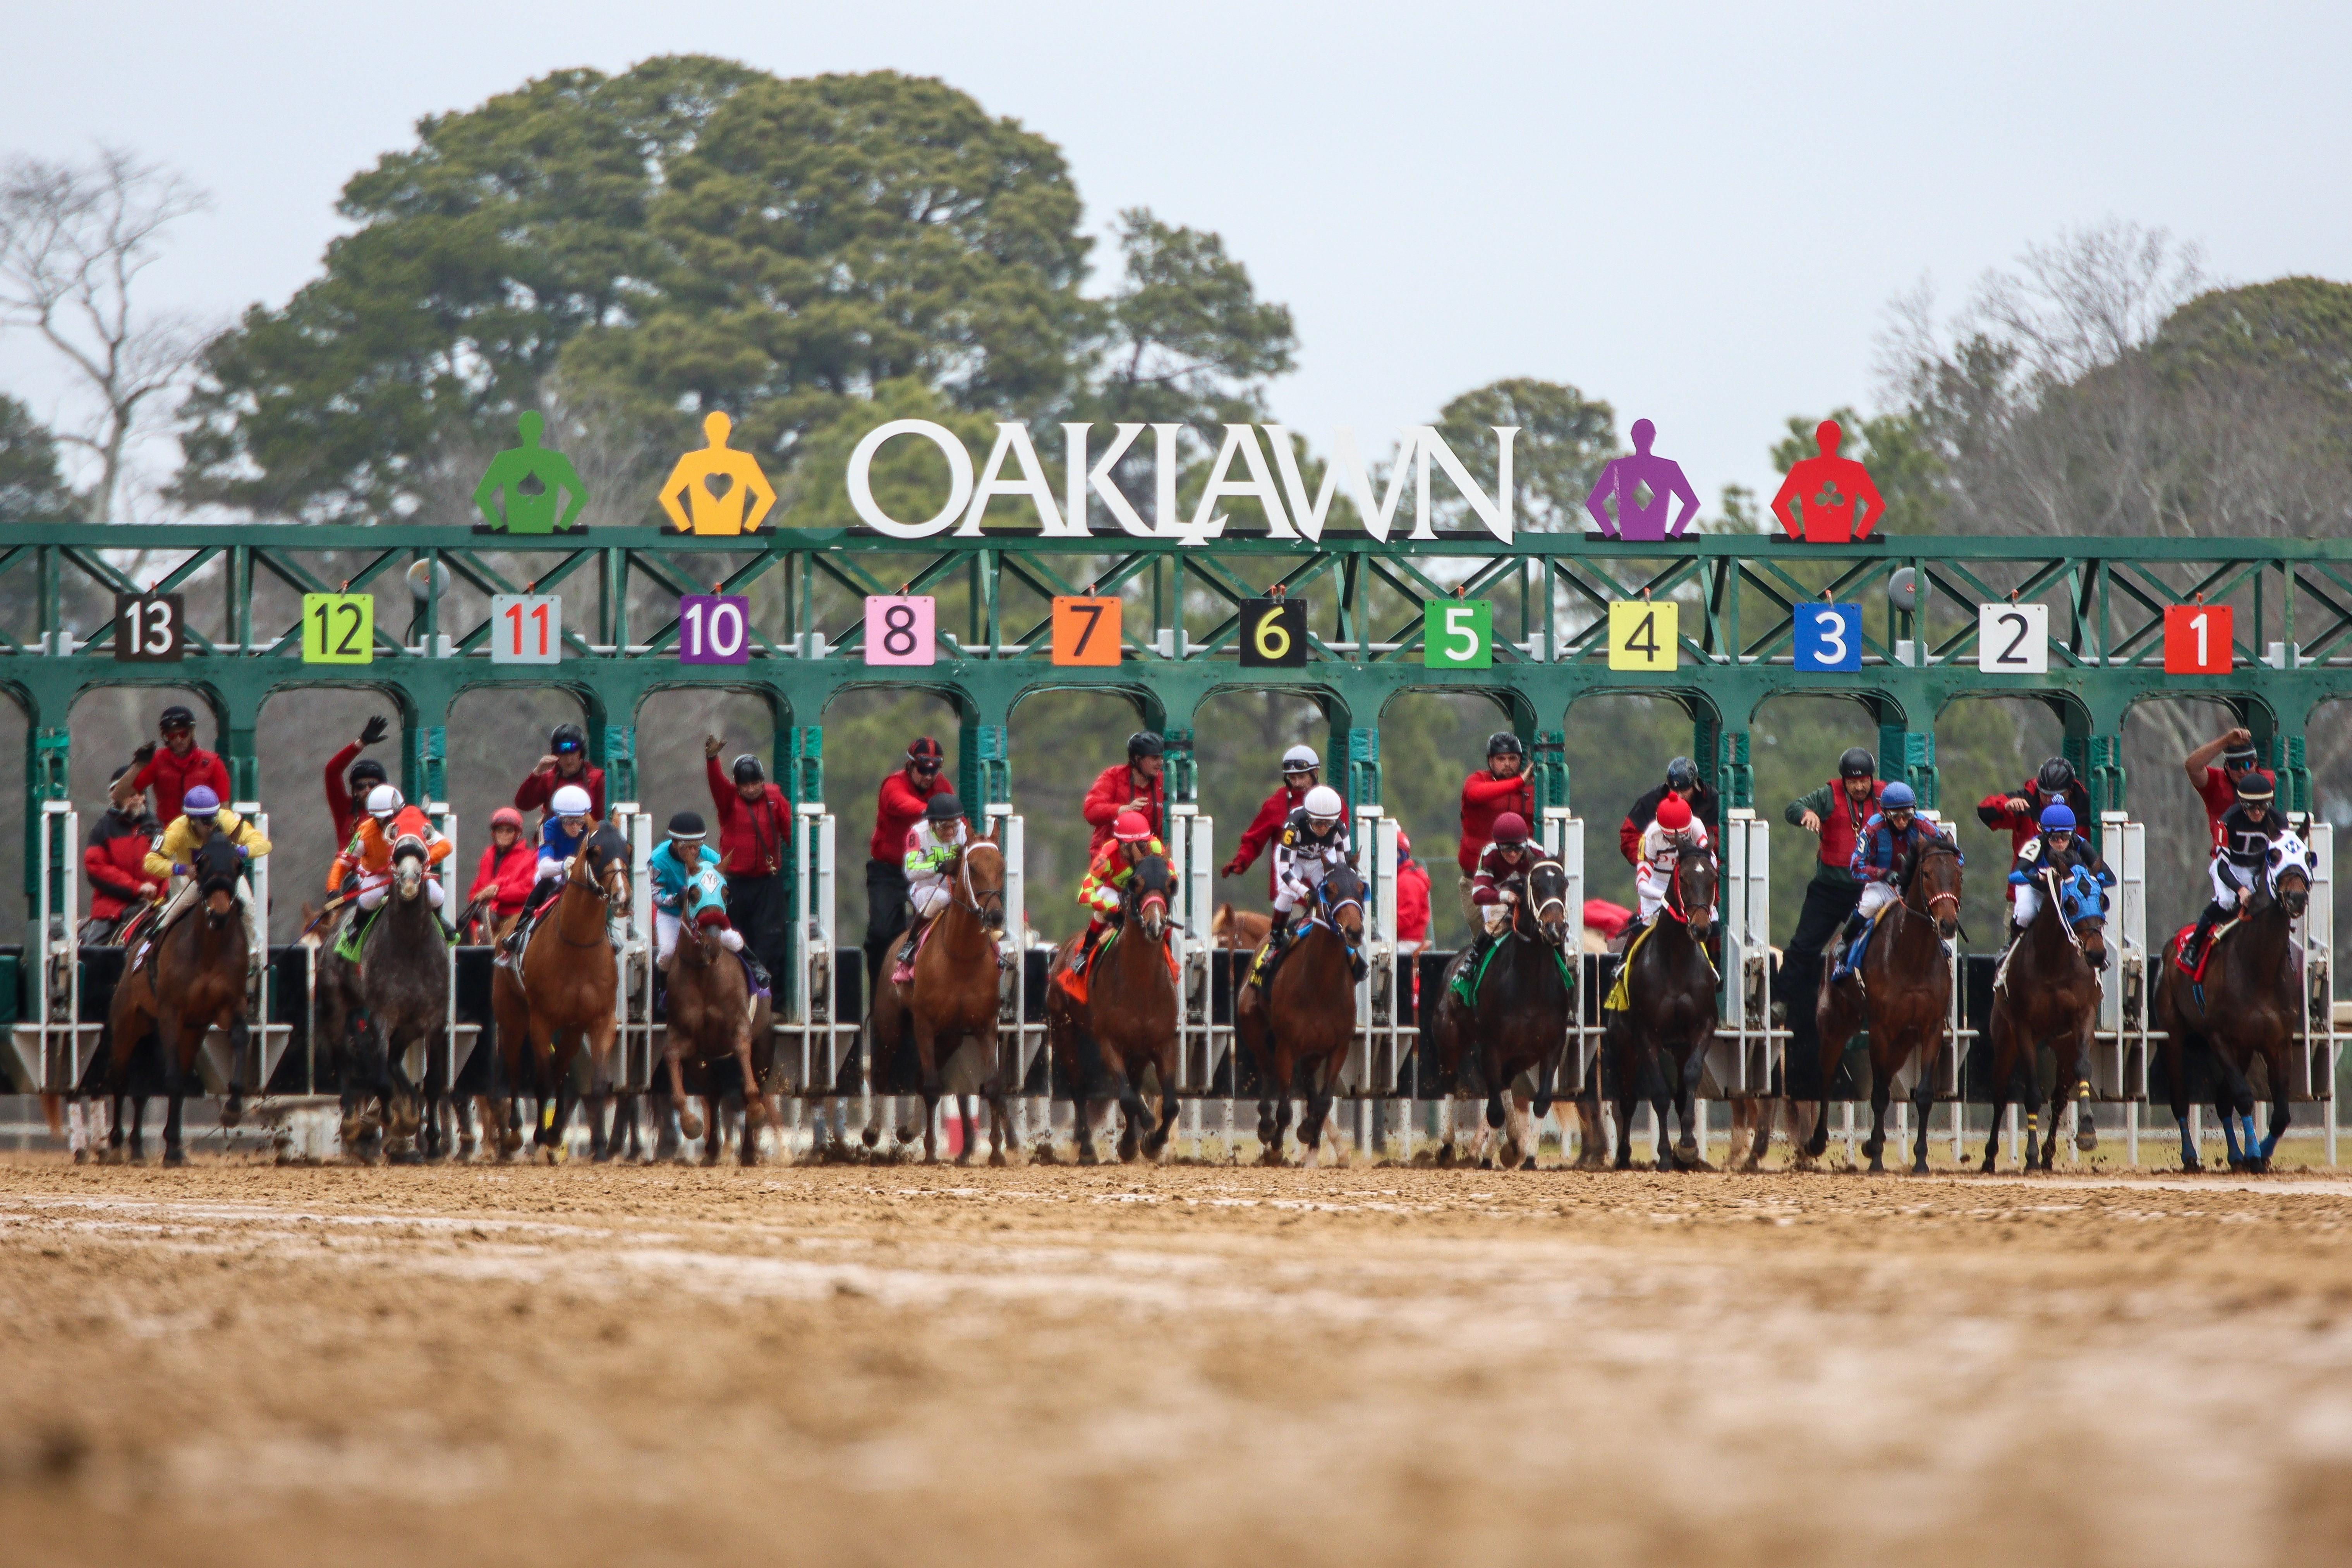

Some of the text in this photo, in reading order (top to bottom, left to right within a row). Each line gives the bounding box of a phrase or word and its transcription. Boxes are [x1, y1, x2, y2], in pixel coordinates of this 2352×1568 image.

[848, 419, 1522, 546] OAKLAWN
[125, 601, 173, 654] 13
[315, 603, 362, 655] 12
[505, 603, 548, 655] 11
[686, 603, 743, 656] 10
[883, 605, 917, 656] 8
[1070, 605, 1104, 657] 7
[1255, 606, 1290, 659] 6
[1445, 608, 1479, 661] 5
[1624, 611, 1660, 662] 4
[1813, 611, 1847, 664] 3
[1997, 613, 2028, 664] 2
[2189, 613, 2208, 666] 1
[1284, 830, 1294, 845] 6
[1857, 836, 1866, 854] 3
[2025, 843, 2038, 857] 2
[2218, 828, 2223, 843] 1
[702, 873, 718, 885] JYR
